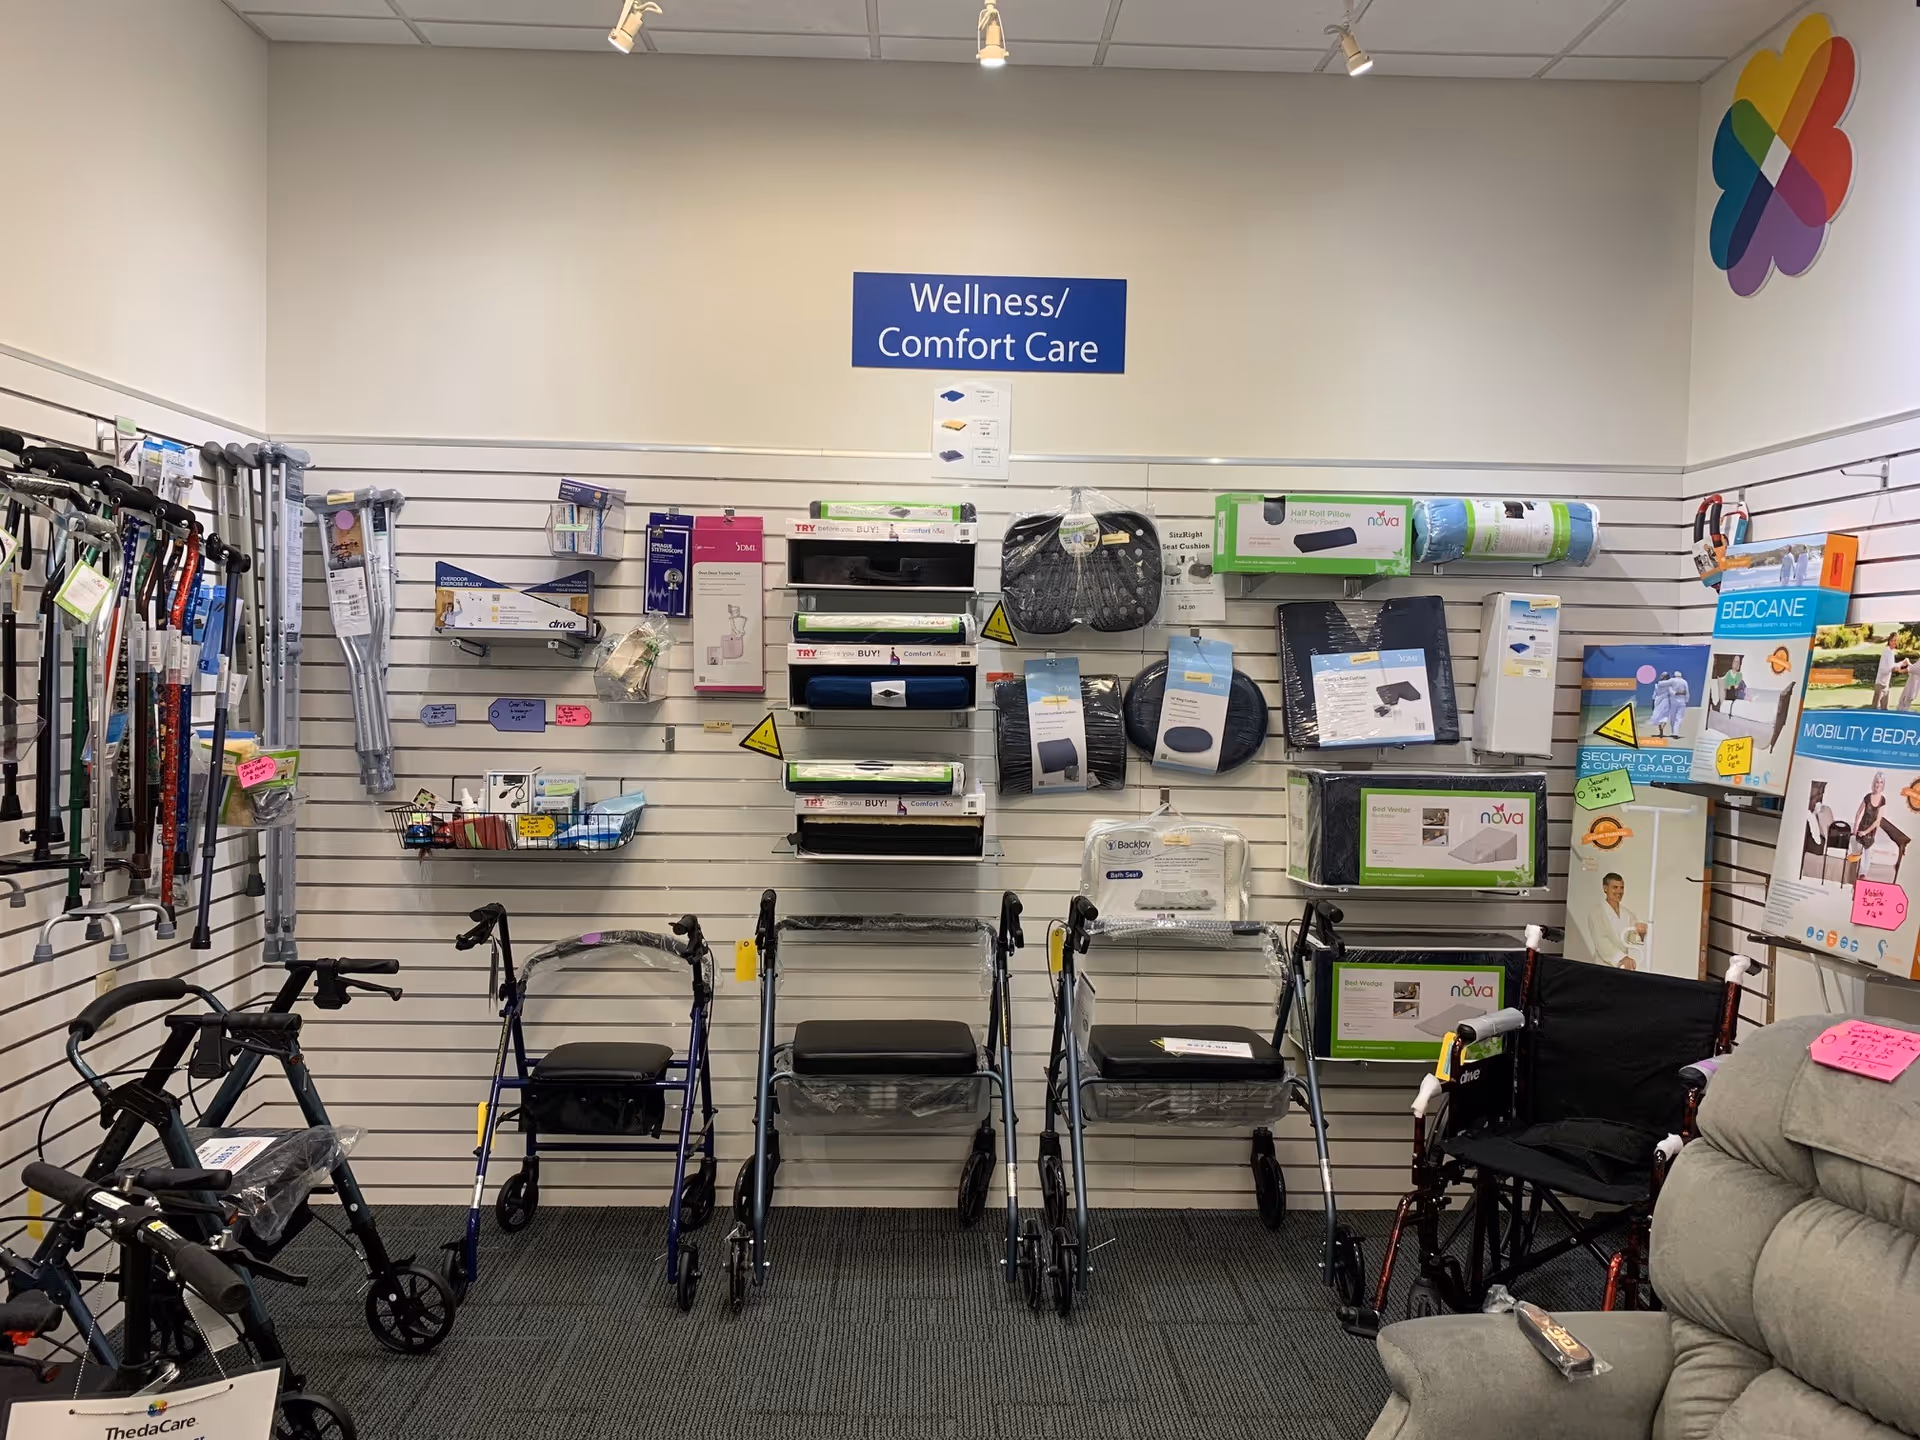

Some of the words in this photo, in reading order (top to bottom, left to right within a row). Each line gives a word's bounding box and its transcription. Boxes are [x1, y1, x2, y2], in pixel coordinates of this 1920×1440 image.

[910, 282, 1070, 318] Wellness/
[878, 326, 1016, 361] Comfort
[1025, 331, 1099, 363] Care
[1290, 509, 1308, 517] Half
[1326, 510, 1351, 518] Pillow
[1290, 518, 1318, 527] Memory
[1367, 516, 1400, 527] nova
[795, 524, 816, 532] TRY
[856, 526, 879, 534] BUY!
[1169, 531, 1203, 539] SitzRight
[1721, 597, 1807, 620] BEDCANE
[548, 619, 576, 629] drive
[796, 649, 817, 657] TRY
[857, 649, 880, 657] BUY!
[1803, 722, 1870, 741] MOBILITY
[1581, 751, 1657, 763] SECURITY
[1661, 754, 1693, 765] POL
[1593, 762, 1636, 771] CURVE
[1637, 764, 1673, 773] GRAB
[1677, 765, 1692, 773] BA
[804, 798, 825, 807] TRY
[865, 799, 888, 807] BUY!
[1480, 810, 1524, 825] nova
[1117, 839, 1151, 849] BackJoy
[1450, 985, 1494, 998] nova
[1460, 1069, 1481, 1085] drive
[105, 1416, 196, 1440] ThedaCare
